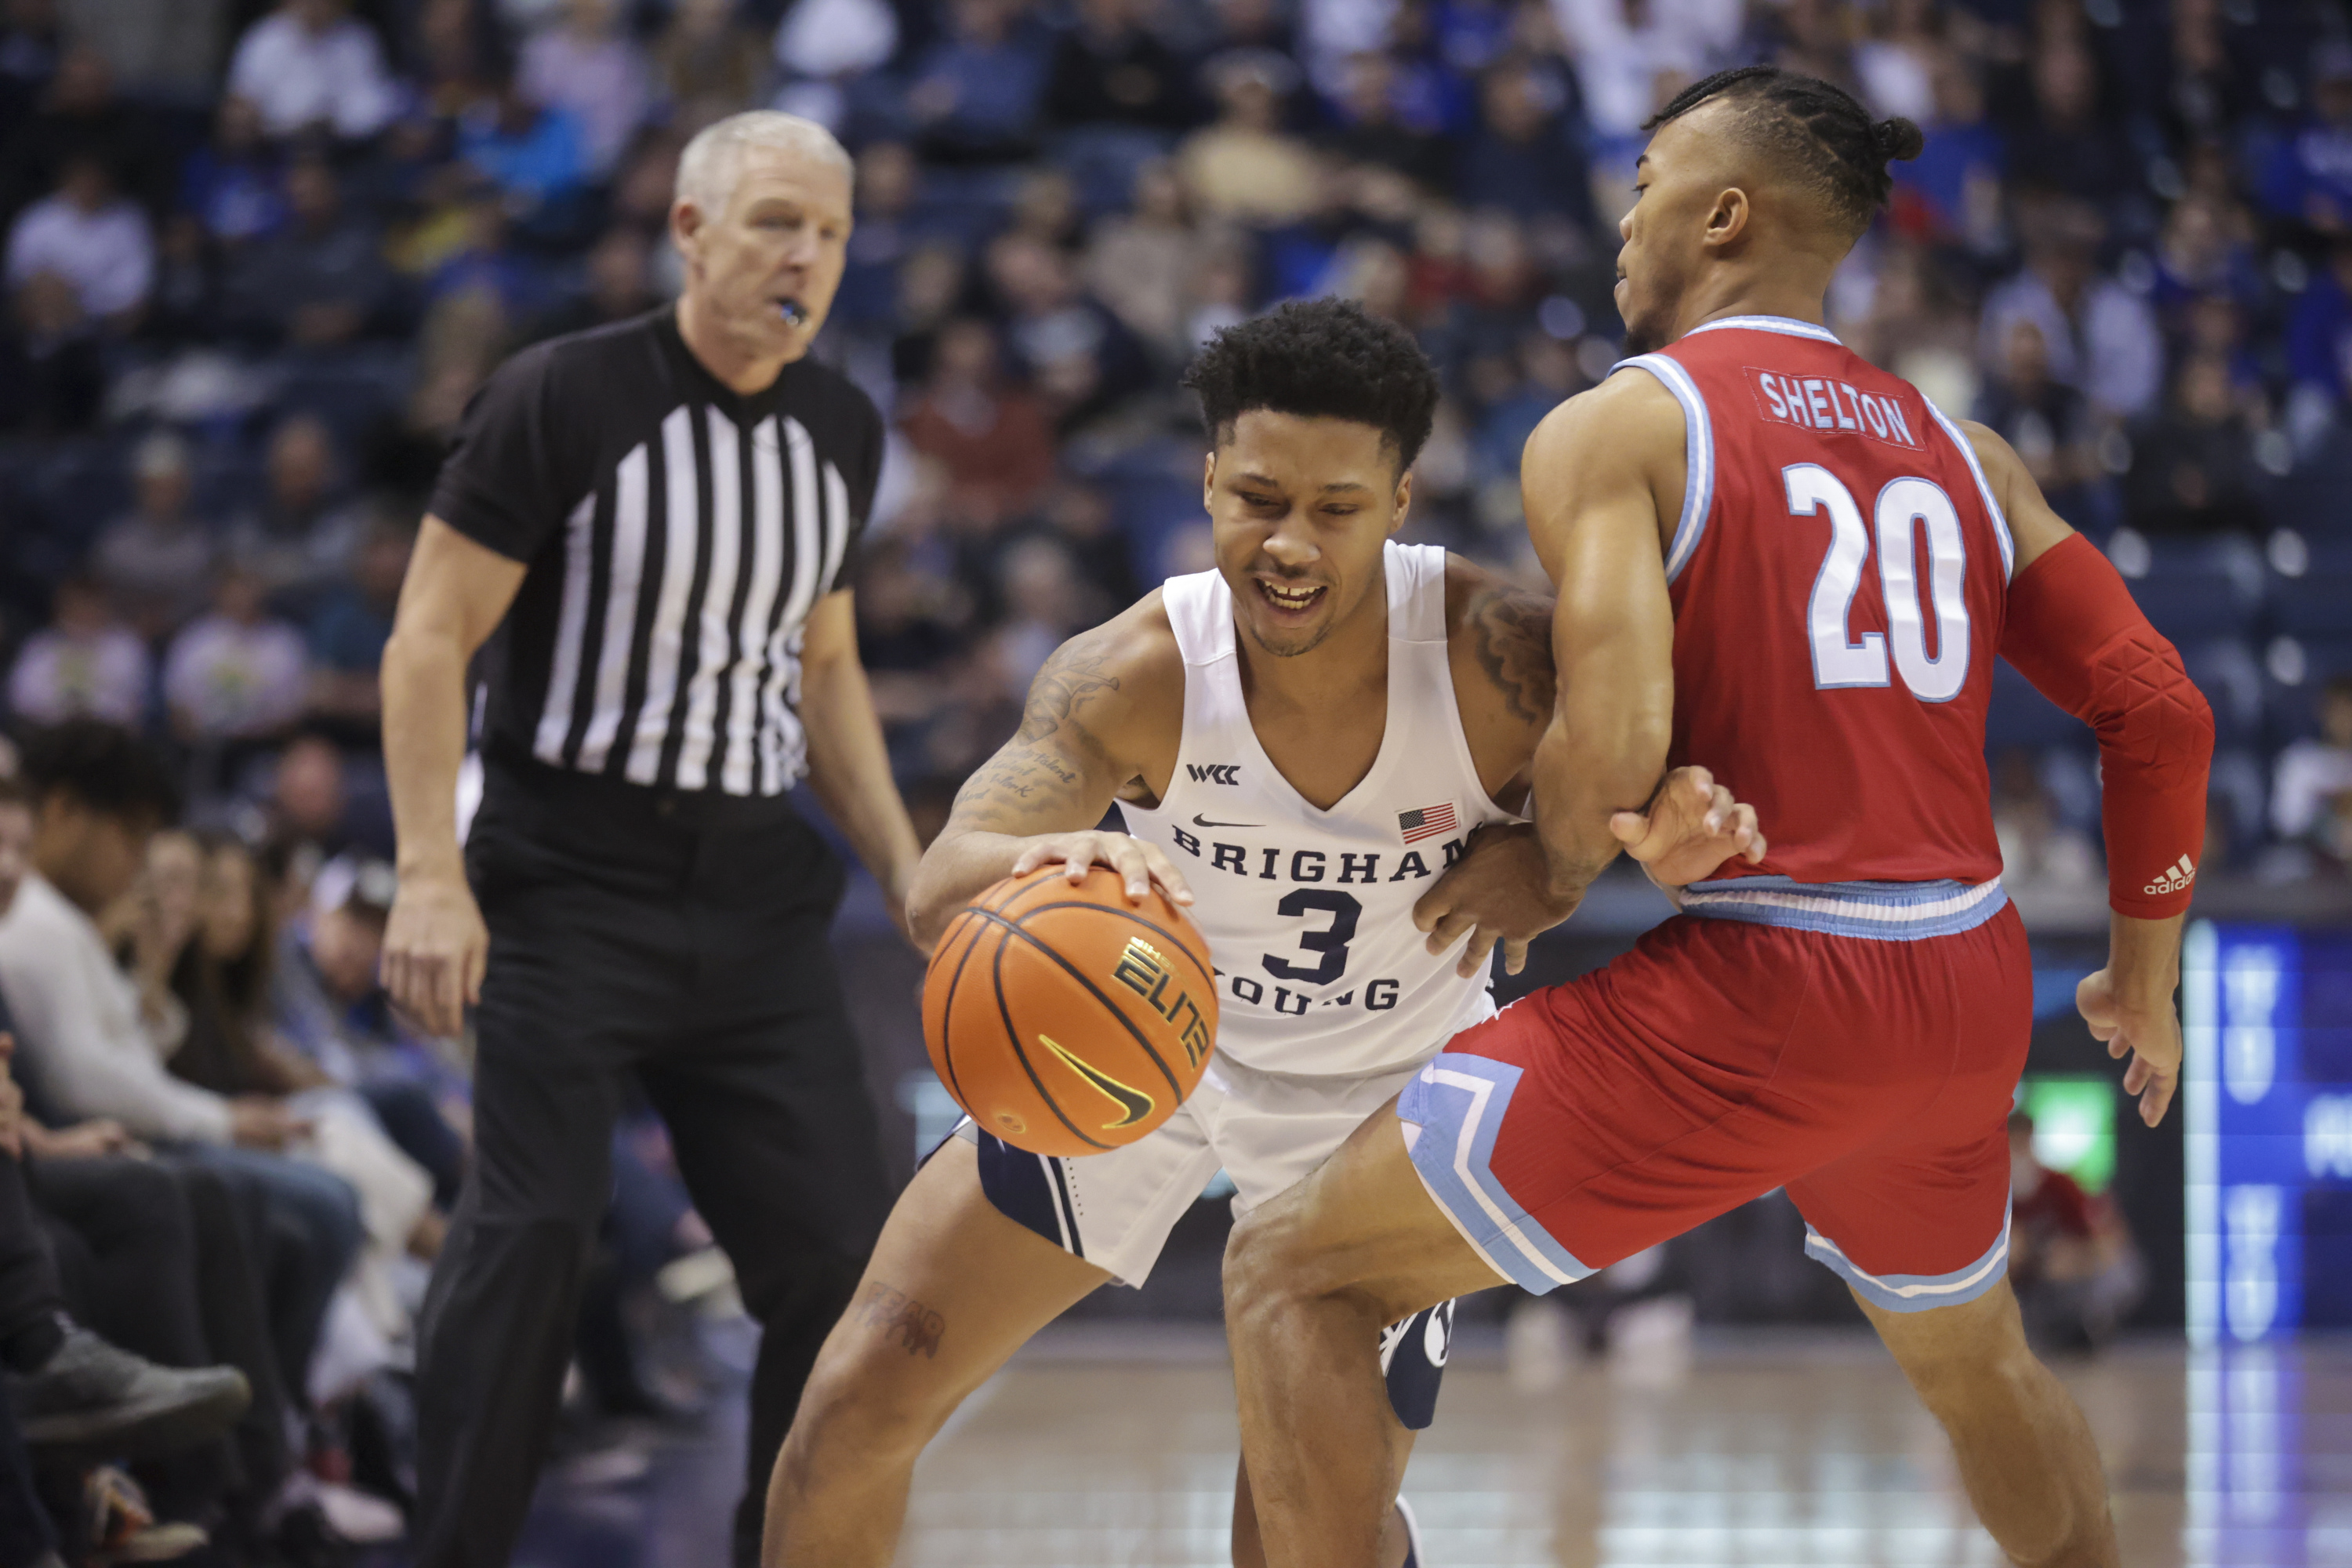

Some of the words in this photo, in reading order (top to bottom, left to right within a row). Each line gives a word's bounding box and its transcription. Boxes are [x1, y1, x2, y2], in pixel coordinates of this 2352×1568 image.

[1759, 372, 1915, 446] SHELTON
[1781, 463, 1971, 703] 20
[1186, 764, 1241, 786] WCC
[2143, 867, 2195, 895] adidas
[1261, 887, 1363, 986] 3
[1111, 943, 1211, 1073] ELITE
